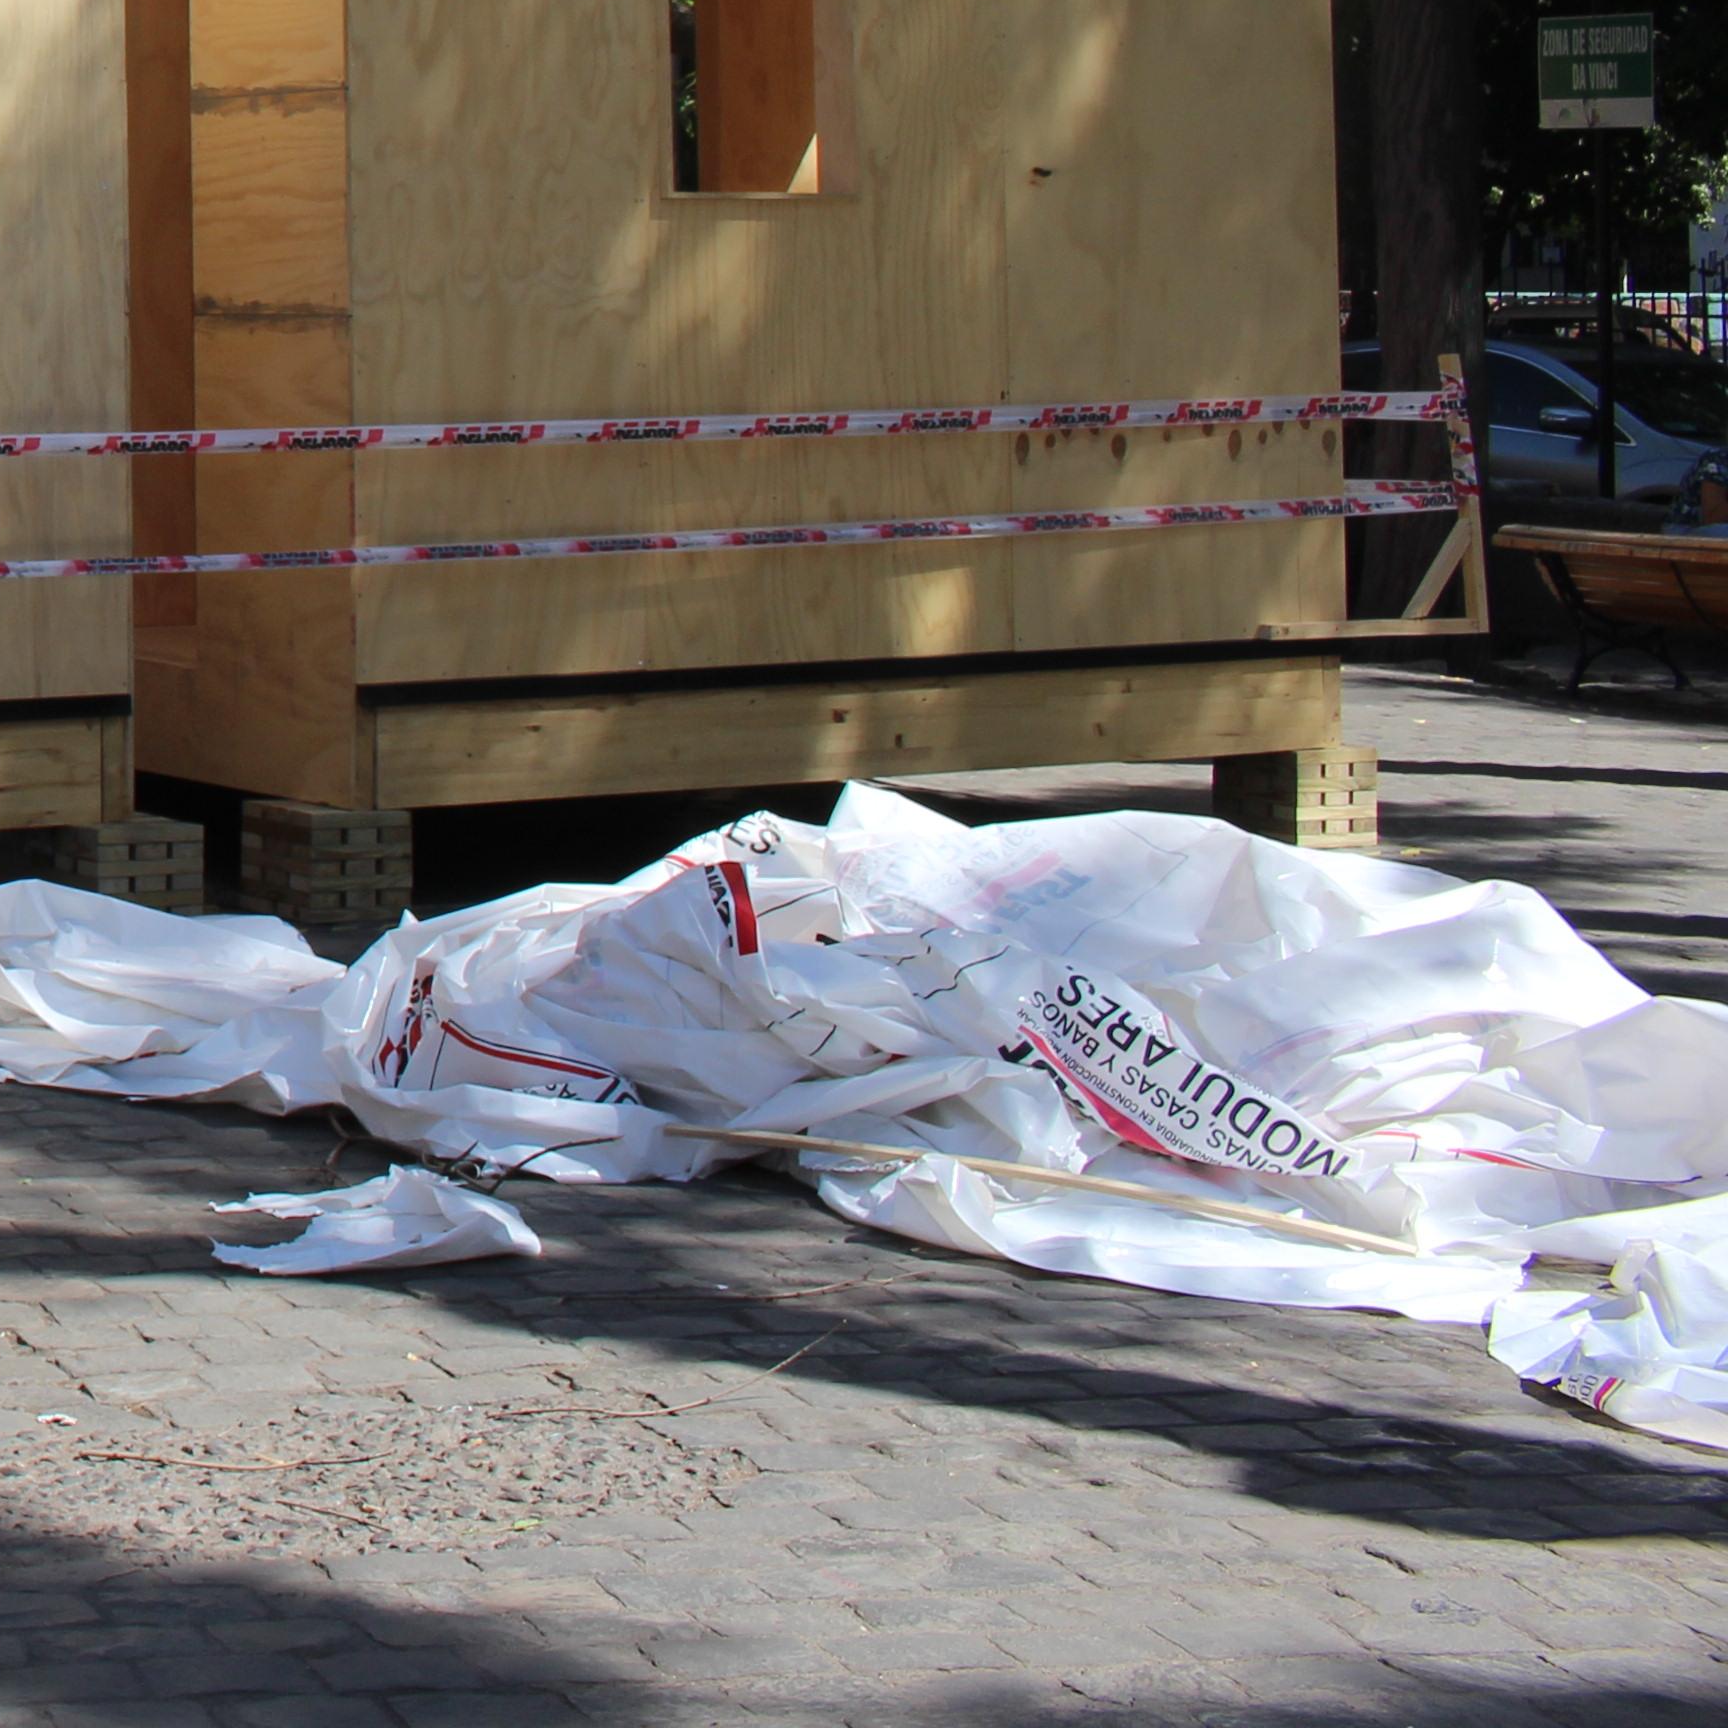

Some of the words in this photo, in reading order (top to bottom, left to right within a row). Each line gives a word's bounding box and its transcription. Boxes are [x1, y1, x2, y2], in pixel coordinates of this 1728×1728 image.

[1543, 29, 1569, 57] ZONA
[1572, 28, 1586, 55] DE
[1588, 25, 1648, 54] SEGURIDAD
[1571, 63, 1586, 90] DA
[1588, 62, 1618, 90] VINCI
[1031, 990, 1100, 1058] BAÑOS
[1099, 1053, 1117, 1073] Y
[1121, 1065, 1199, 1130] CASAS
[1142, 1109, 1156, 1124] EN
